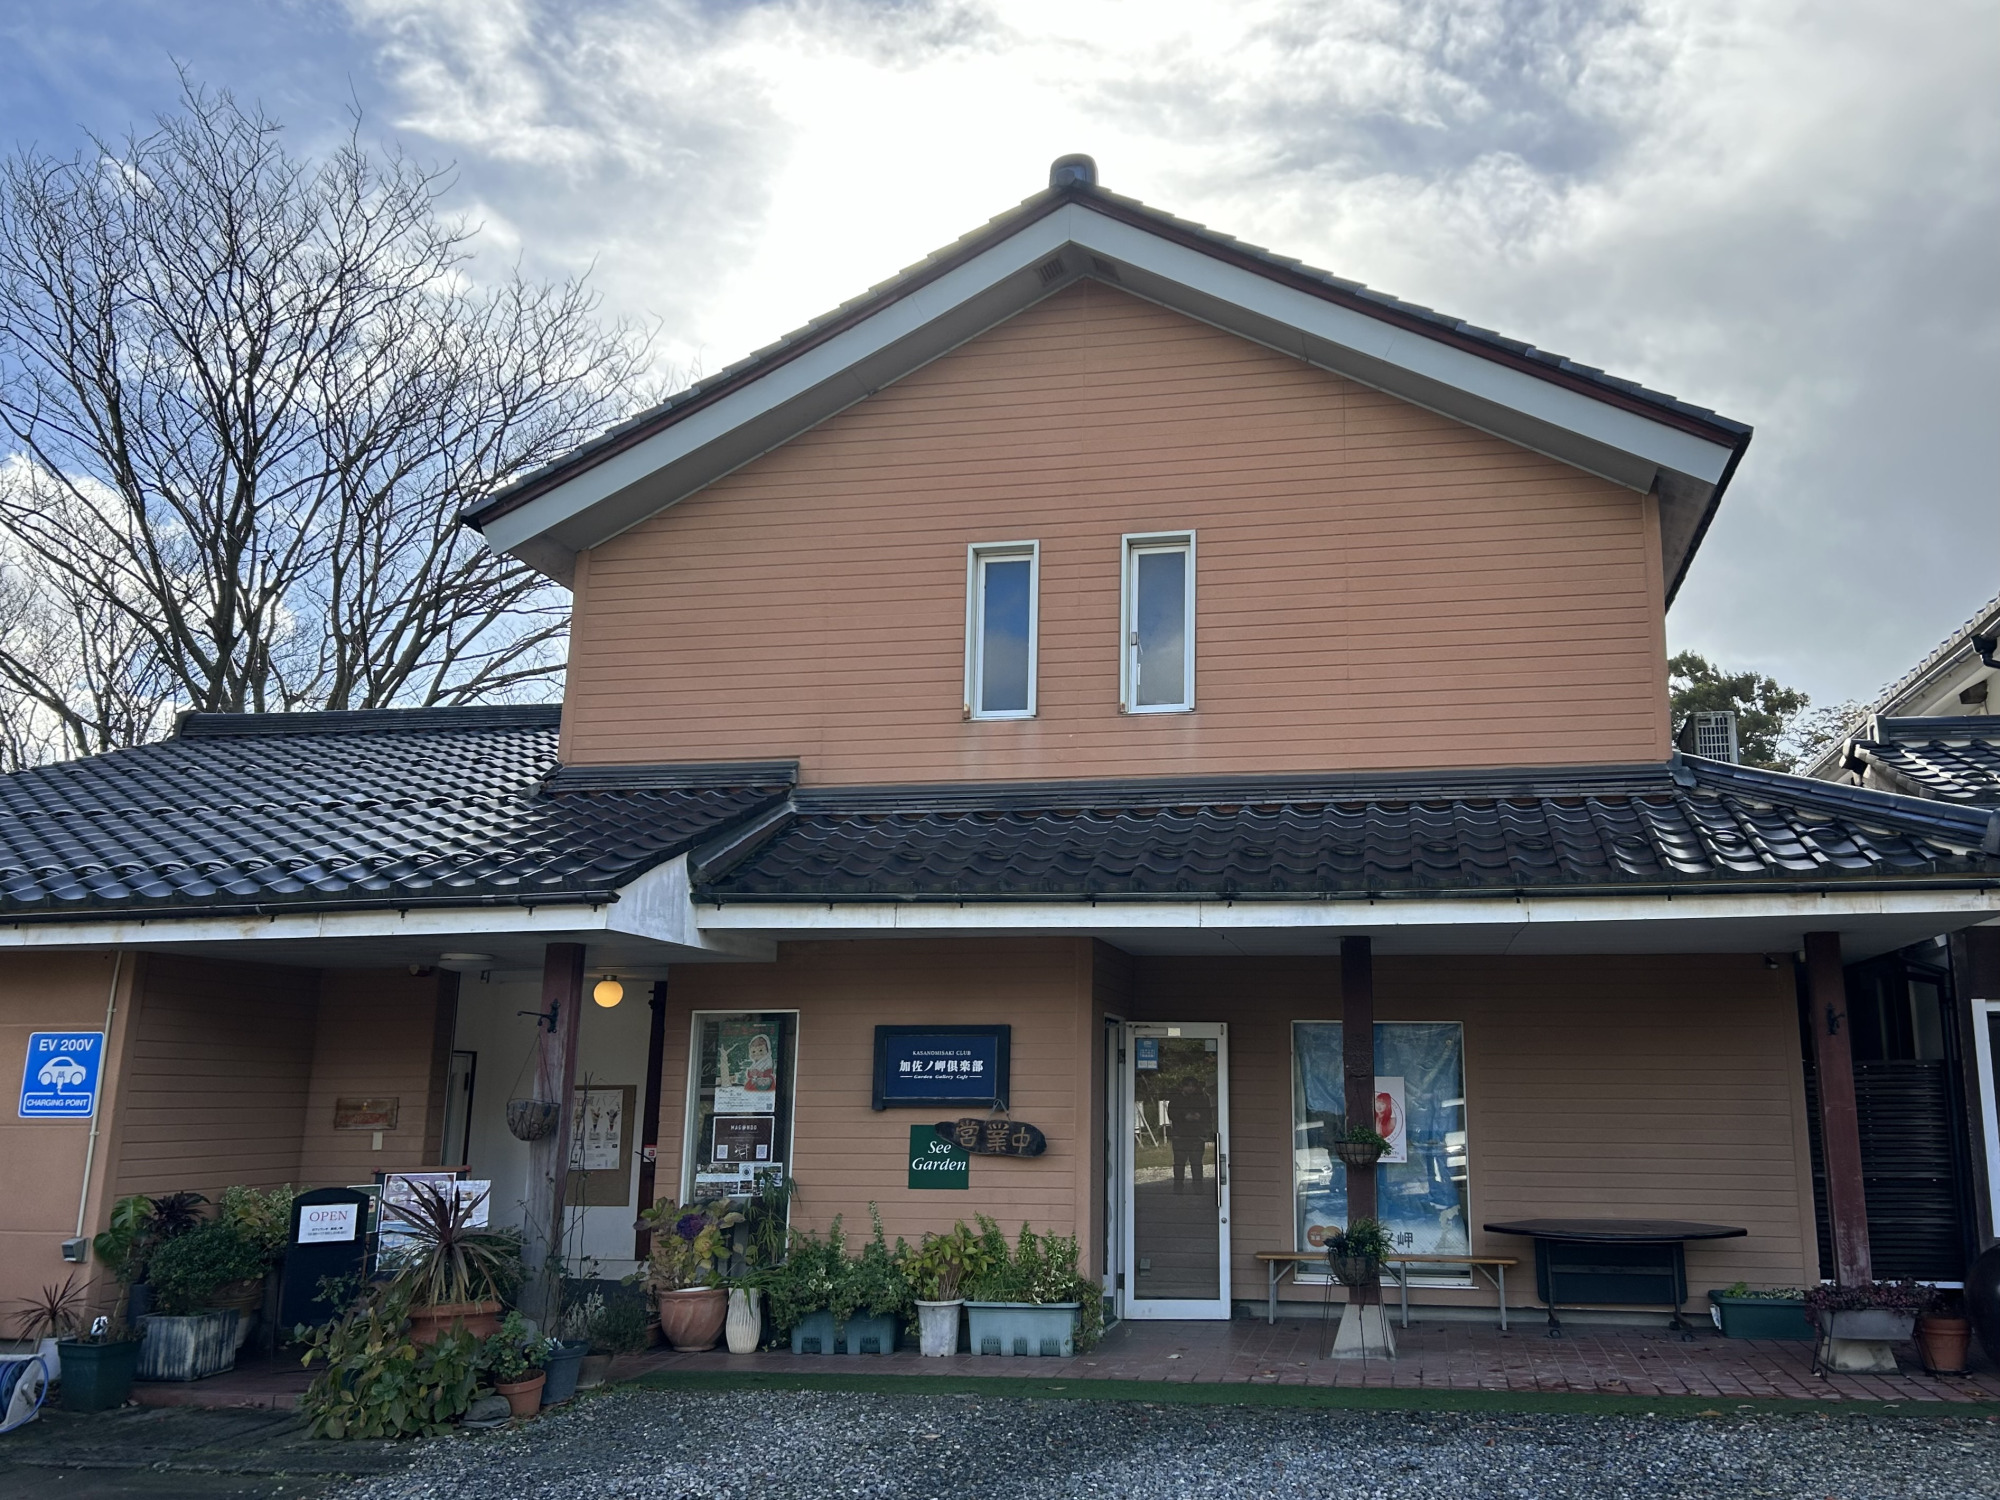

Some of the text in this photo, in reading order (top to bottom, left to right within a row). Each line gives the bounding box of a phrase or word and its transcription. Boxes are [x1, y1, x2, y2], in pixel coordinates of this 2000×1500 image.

[39, 1039, 93, 1051] EV 200V
[899, 1060, 984, 1072] 加佐ノ岬倶楽部
[26, 1099, 88, 1107] CHARGING POINT
[955, 1120, 1031, 1153] 営業中
[928, 1141, 951, 1154] See
[912, 1158, 967, 1171] Garden
[309, 1210, 348, 1222] OPEN
